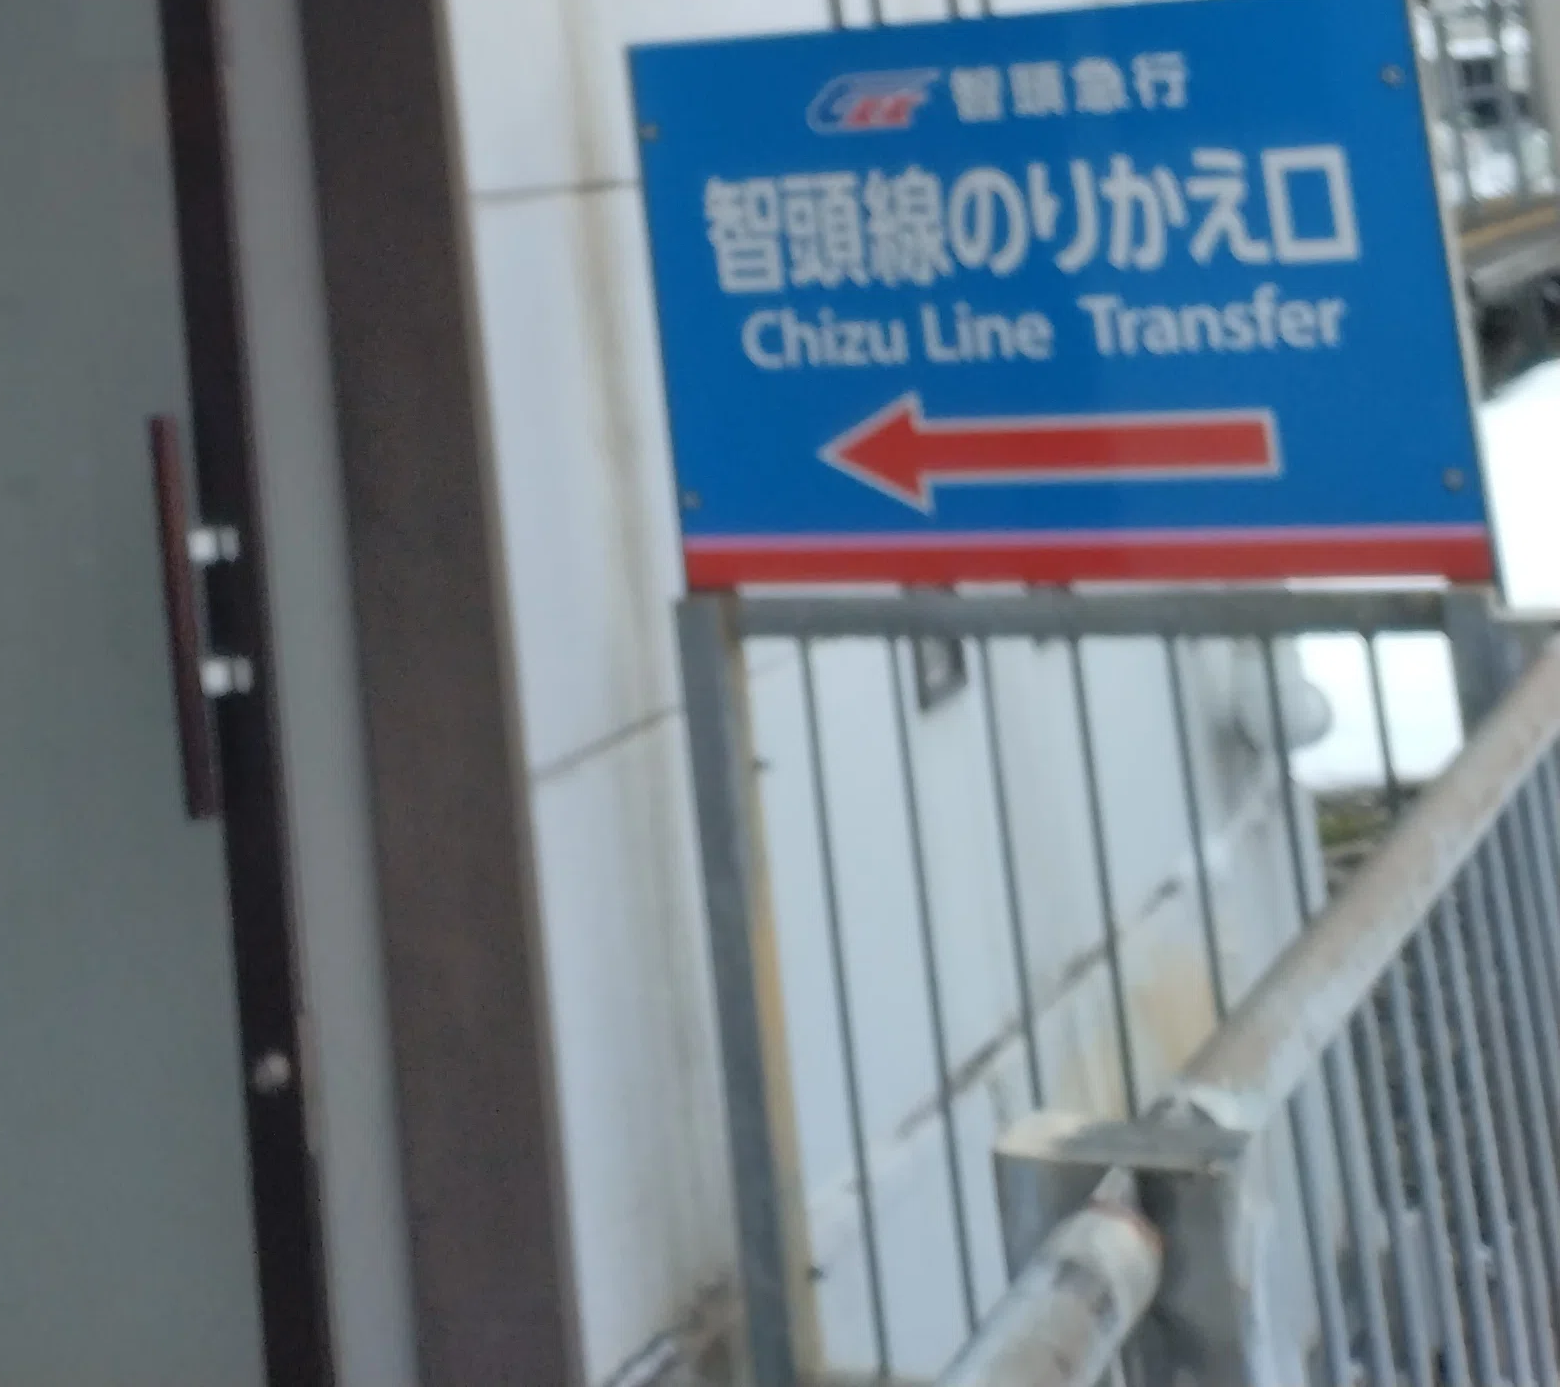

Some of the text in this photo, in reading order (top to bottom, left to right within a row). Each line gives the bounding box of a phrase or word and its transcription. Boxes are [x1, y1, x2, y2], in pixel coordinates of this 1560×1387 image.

[949, 50, 1189, 124] 智頭急行
[702, 143, 1360, 294] 智頭線のりかえ口
[741, 282, 1346, 372] Chizu Line Transfer
